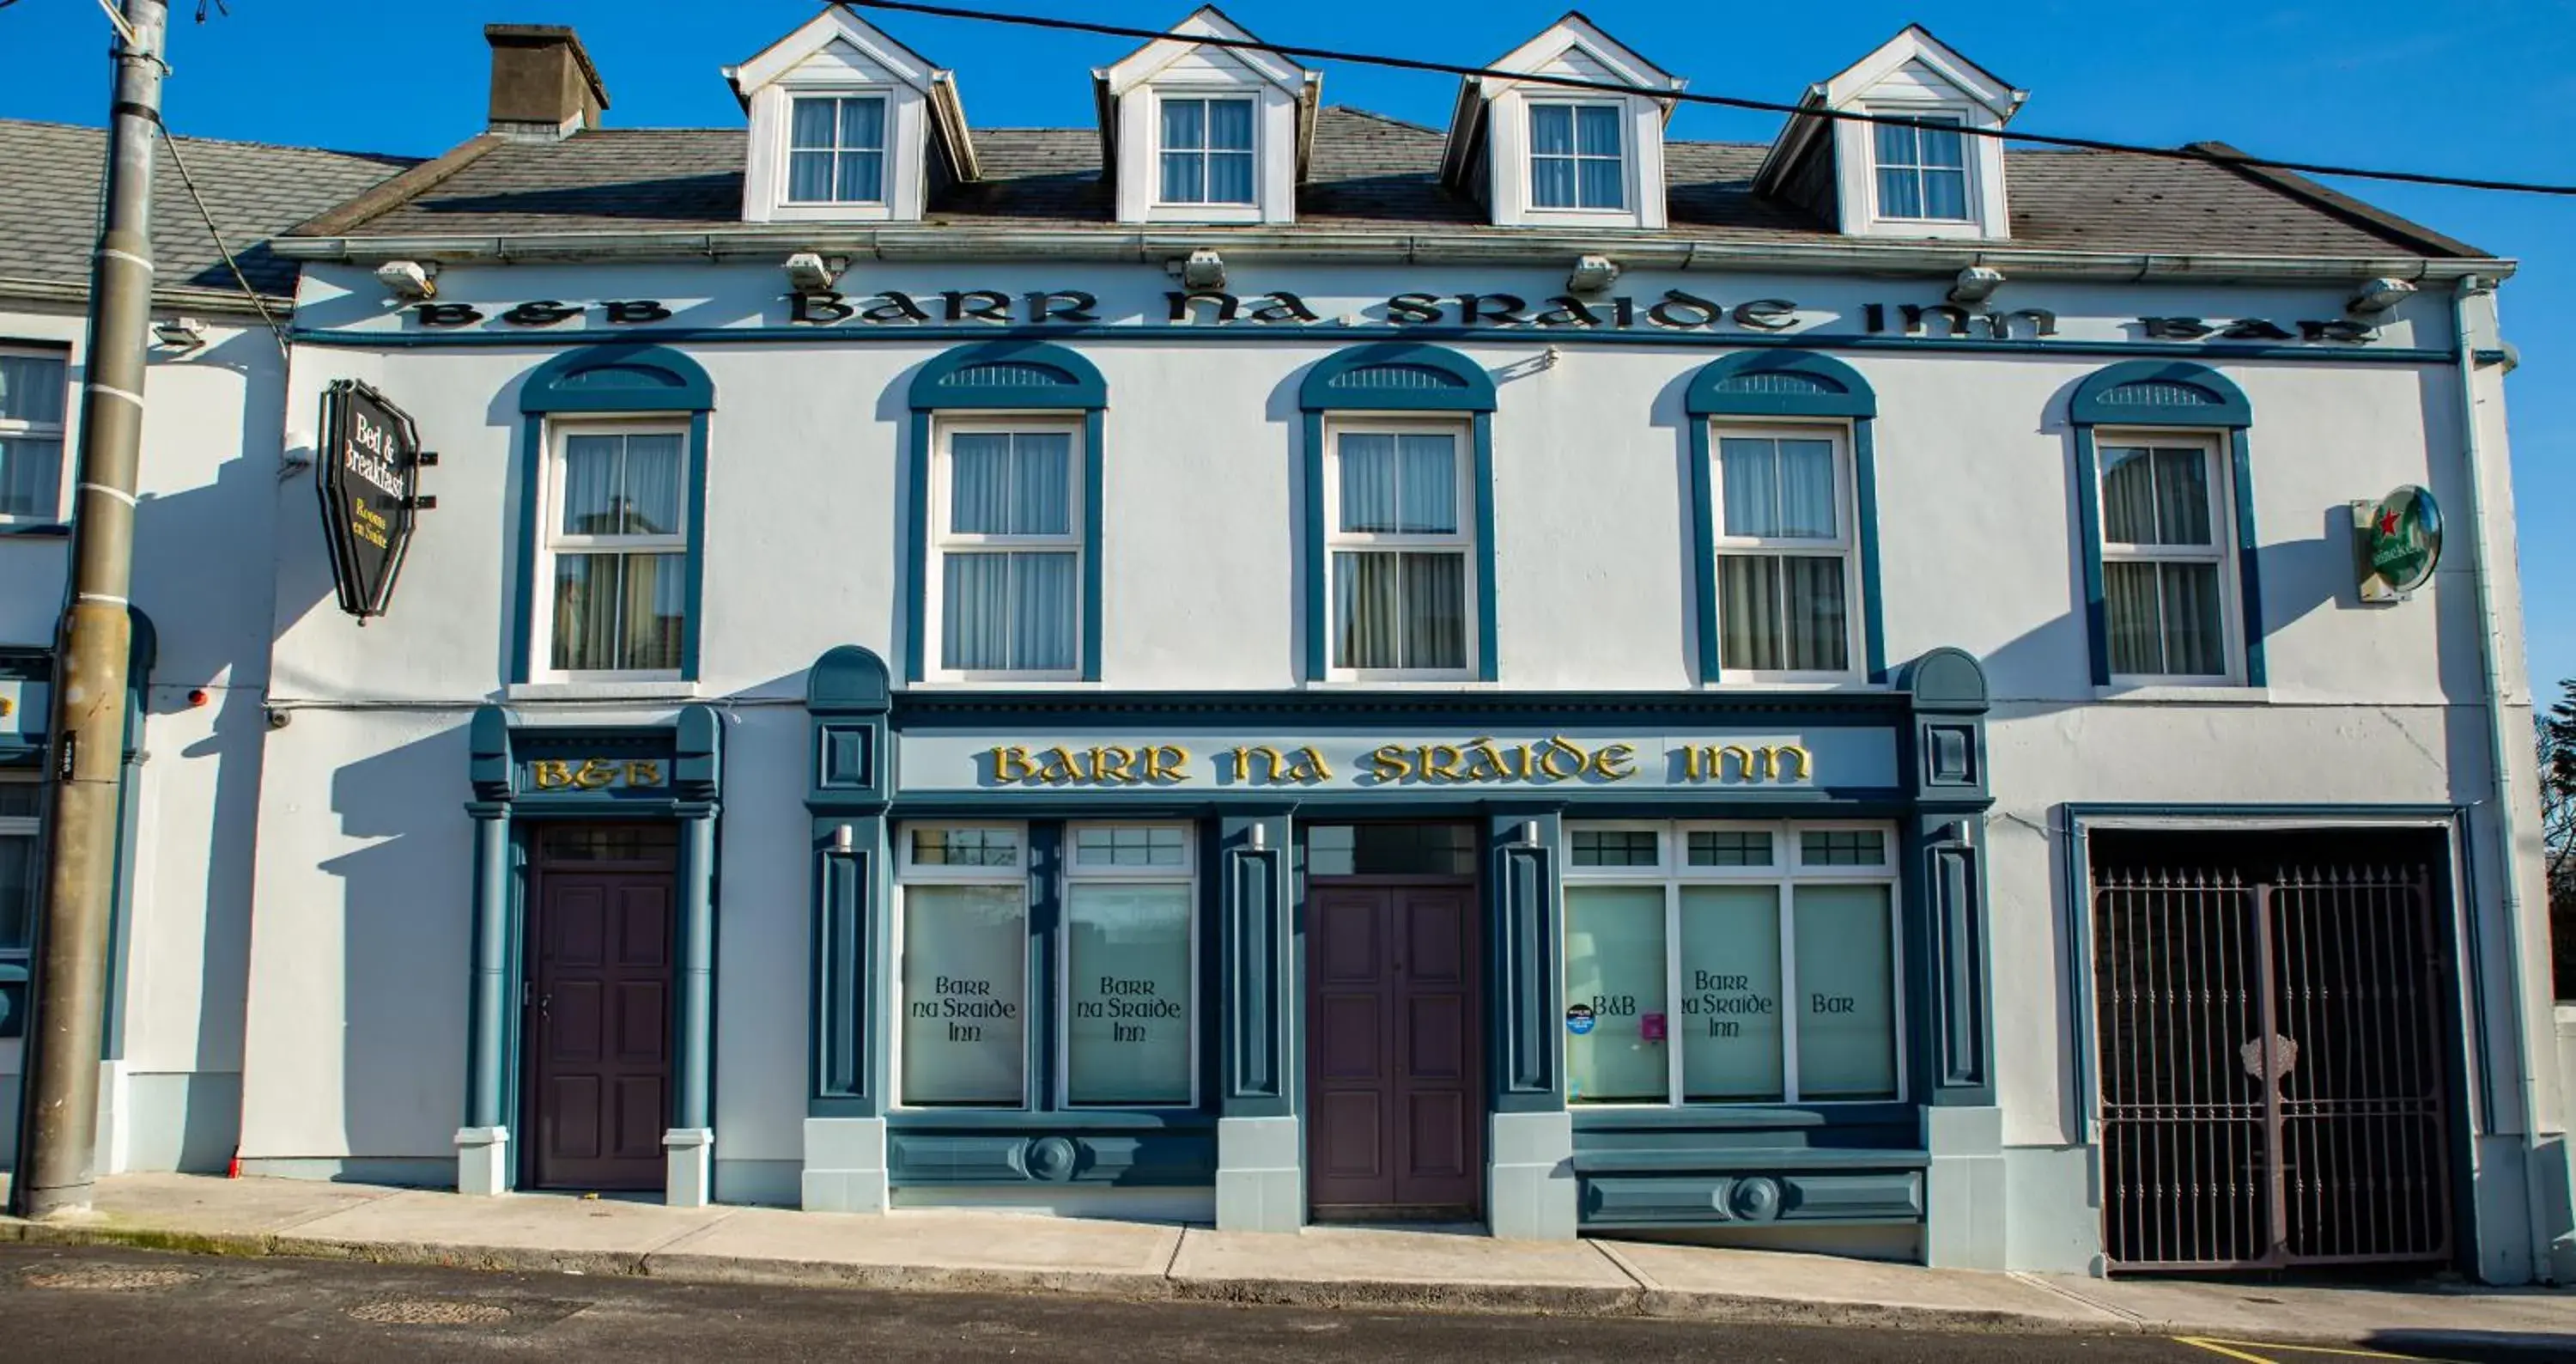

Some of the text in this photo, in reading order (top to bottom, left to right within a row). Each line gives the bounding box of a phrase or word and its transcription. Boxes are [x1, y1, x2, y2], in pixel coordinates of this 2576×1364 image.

[412, 300, 677, 327] B&B
[783, 289, 1102, 324] BARR
[2137, 316, 2379, 343] BAR
[355, 411, 395, 465] Bed &
[345, 439, 404, 502] Breakfast
[532, 757, 663, 789] B&B
[990, 744, 1194, 784] BARR
[935, 976, 990, 996] Barr
[1100, 976, 1155, 996] Barr
[1695, 970, 1748, 990] Barr
[913, 997, 1016, 1018] na Sraide
[1077, 997, 1182, 1018] na Sraide
[1593, 996, 1636, 1016] B&B
[1704, 994, 1772, 1014] Sraide
[1812, 993, 1855, 1014] Bar
[949, 1021, 981, 1042] Inn
[1114, 1021, 1146, 1042] Inn
[1709, 1016, 1739, 1038] Inn
